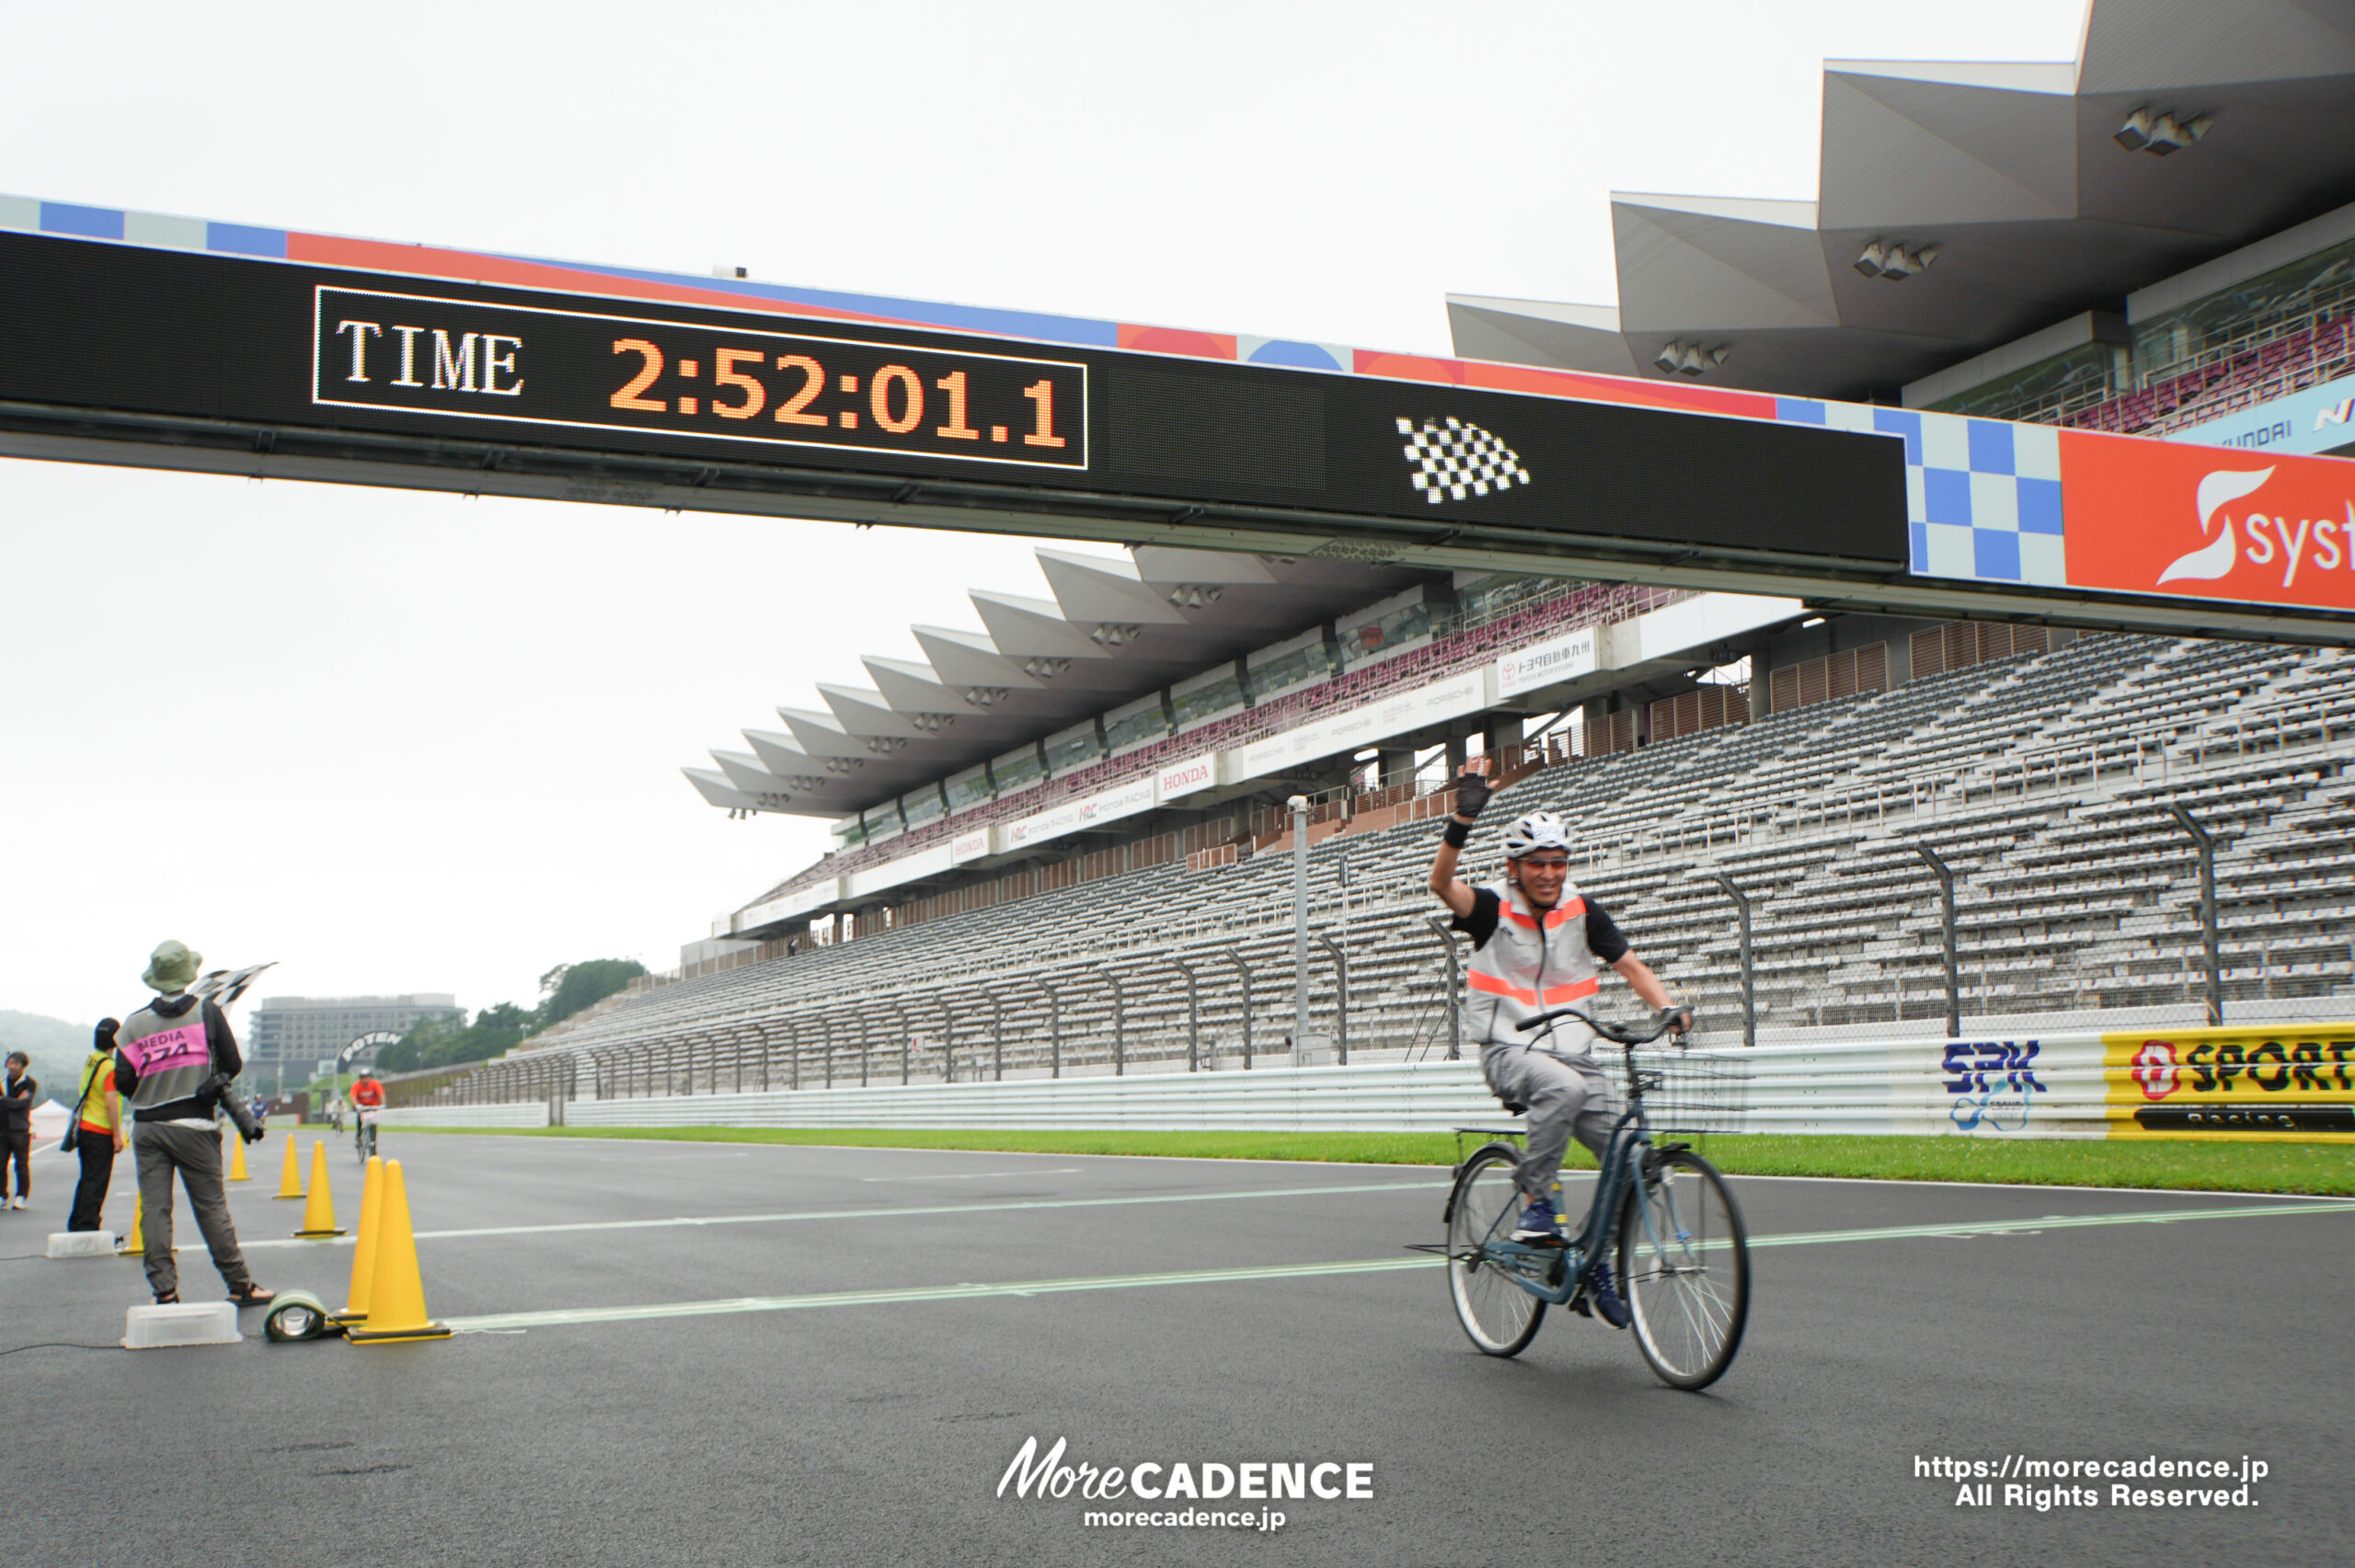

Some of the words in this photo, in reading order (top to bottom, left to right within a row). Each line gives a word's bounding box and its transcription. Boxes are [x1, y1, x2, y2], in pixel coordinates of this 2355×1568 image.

[336, 319, 524, 395] TIME
[610, 338, 1066, 447] 2:52:01.1
[1518, 673, 1536, 684] TOYOTA
[1537, 668, 1555, 679] MOTOR
[1427, 685, 1474, 706] PORSCHE
[1331, 717, 1372, 737] PORSCHE
[1164, 764, 1209, 791] HONDA
[1099, 799, 1123, 812] Honda
[1124, 788, 1152, 804] RACING
[955, 837, 985, 856] HONDA
[137, 1030, 185, 1052] MEDIA
[1941, 1039, 2048, 1093] SPK
